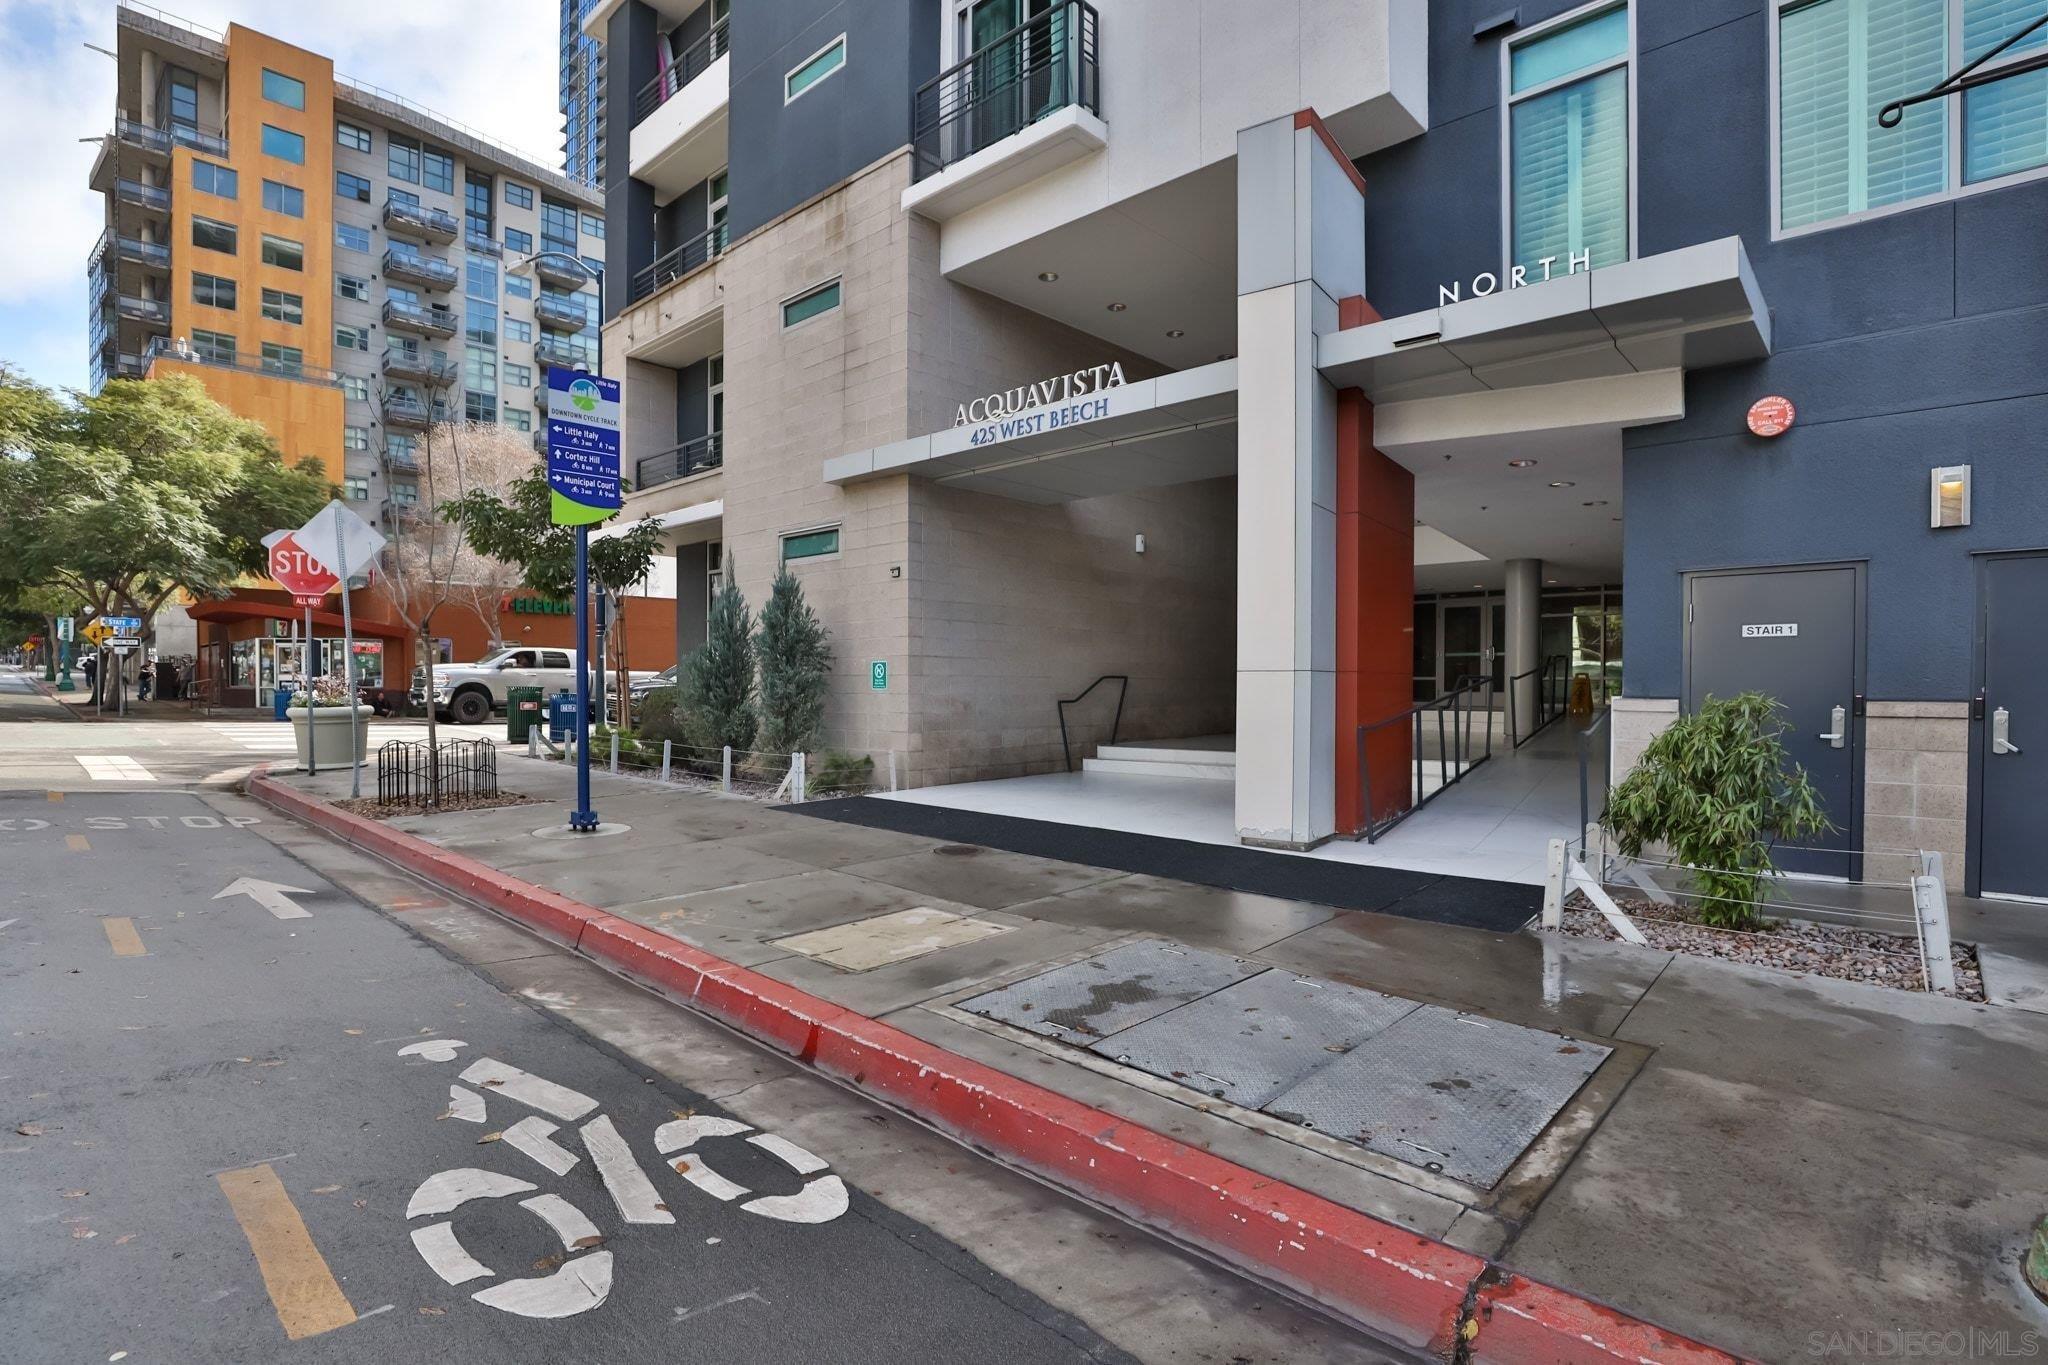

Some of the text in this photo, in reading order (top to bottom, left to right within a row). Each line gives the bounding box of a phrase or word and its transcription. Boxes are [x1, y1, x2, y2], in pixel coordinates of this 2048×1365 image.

[1439, 247, 1591, 307] NORTH
[596, 379, 617, 390] Little Italy
[954, 361, 1128, 428] ACQUAVISTA
[552, 408, 617, 426] DOWNTOWN CYCLE TRACK
[971, 398, 1109, 446] 425 WEST BEECH
[564, 427, 599, 441] Little Italy
[565, 452, 587, 462] Cortez
[564, 476, 615, 490] Municipal Court
[276, 550, 334, 576] STO
[296, 597, 307, 605] ALL
[278, 621, 287, 637] 7
[1746, 625, 1793, 635] STAIR 1
[85, 815, 262, 830] STOP
